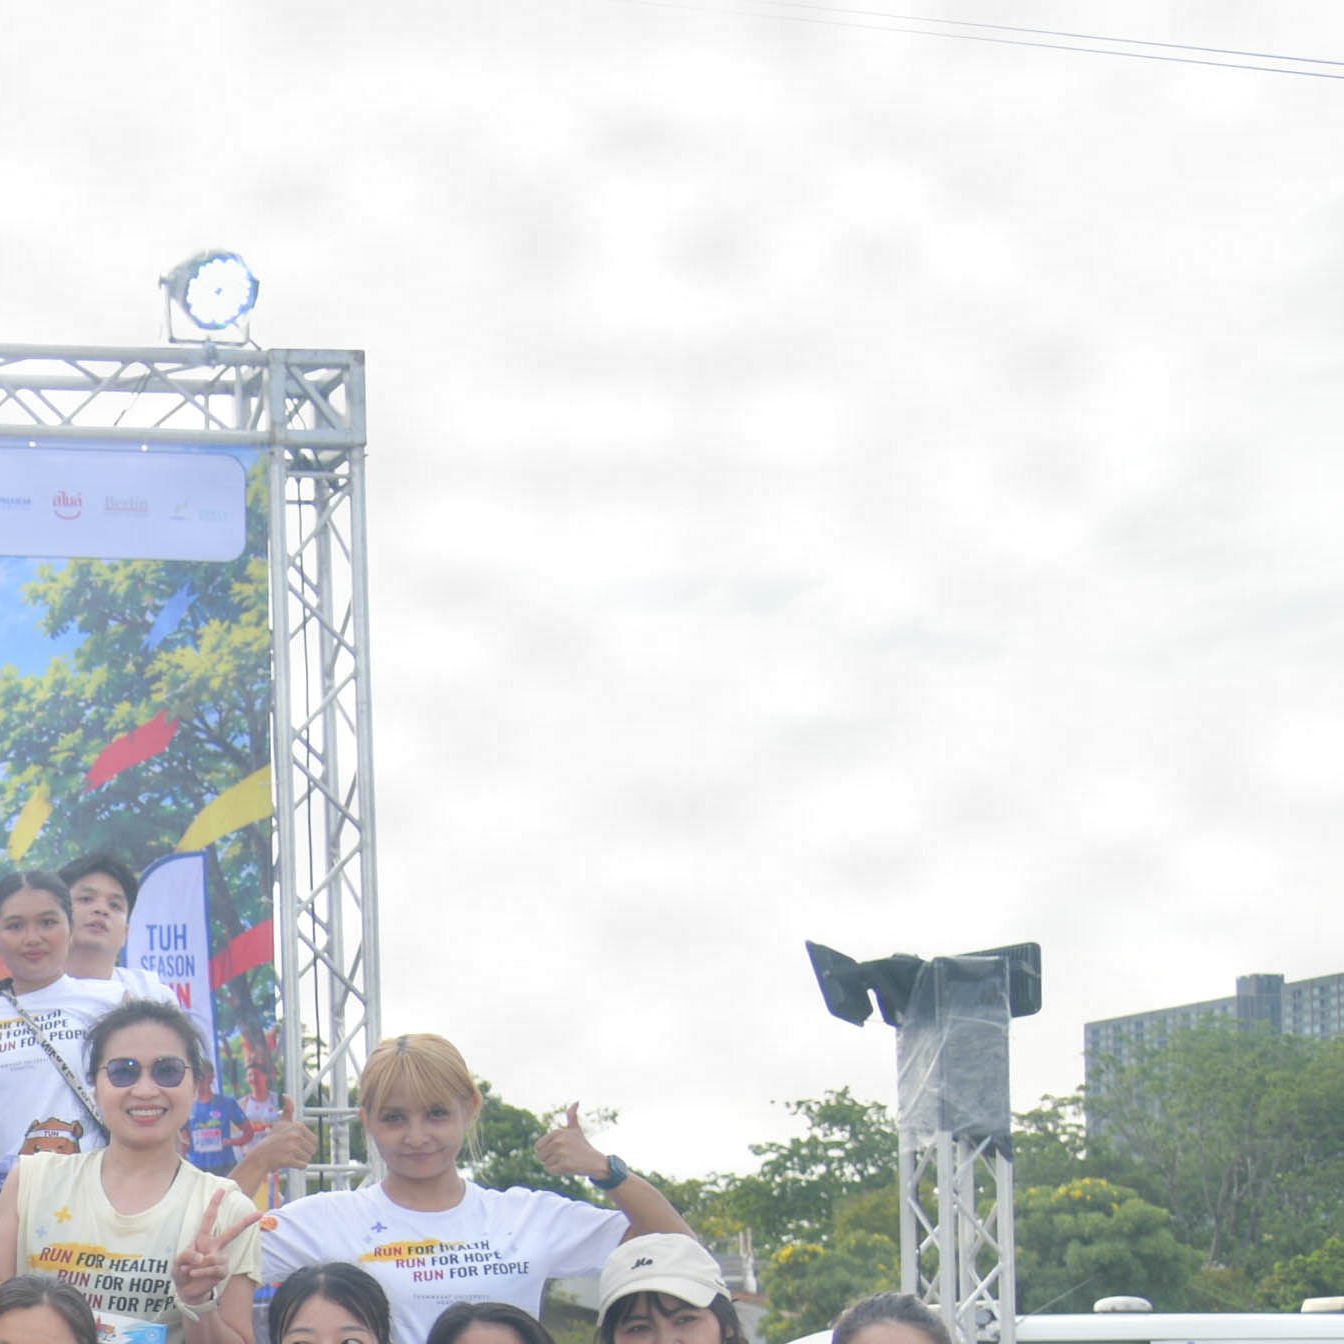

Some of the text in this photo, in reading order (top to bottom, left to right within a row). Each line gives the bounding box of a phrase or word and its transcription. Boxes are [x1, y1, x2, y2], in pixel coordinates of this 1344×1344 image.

[145, 923, 188, 951] TUH
[140, 954, 196, 977] SEASON
[39, 1246, 168, 1275] RUN FOR HEALTH
[373, 1245, 403, 1258] RUN
[407, 1242, 435, 1255] FOR
[395, 1250, 503, 1269] RUN FOR HOPE
[56, 1269, 123, 1291] RUN FOR
[412, 1260, 530, 1282] RUN FOR PEOPLE
[107, 1295, 139, 1312] FOR
